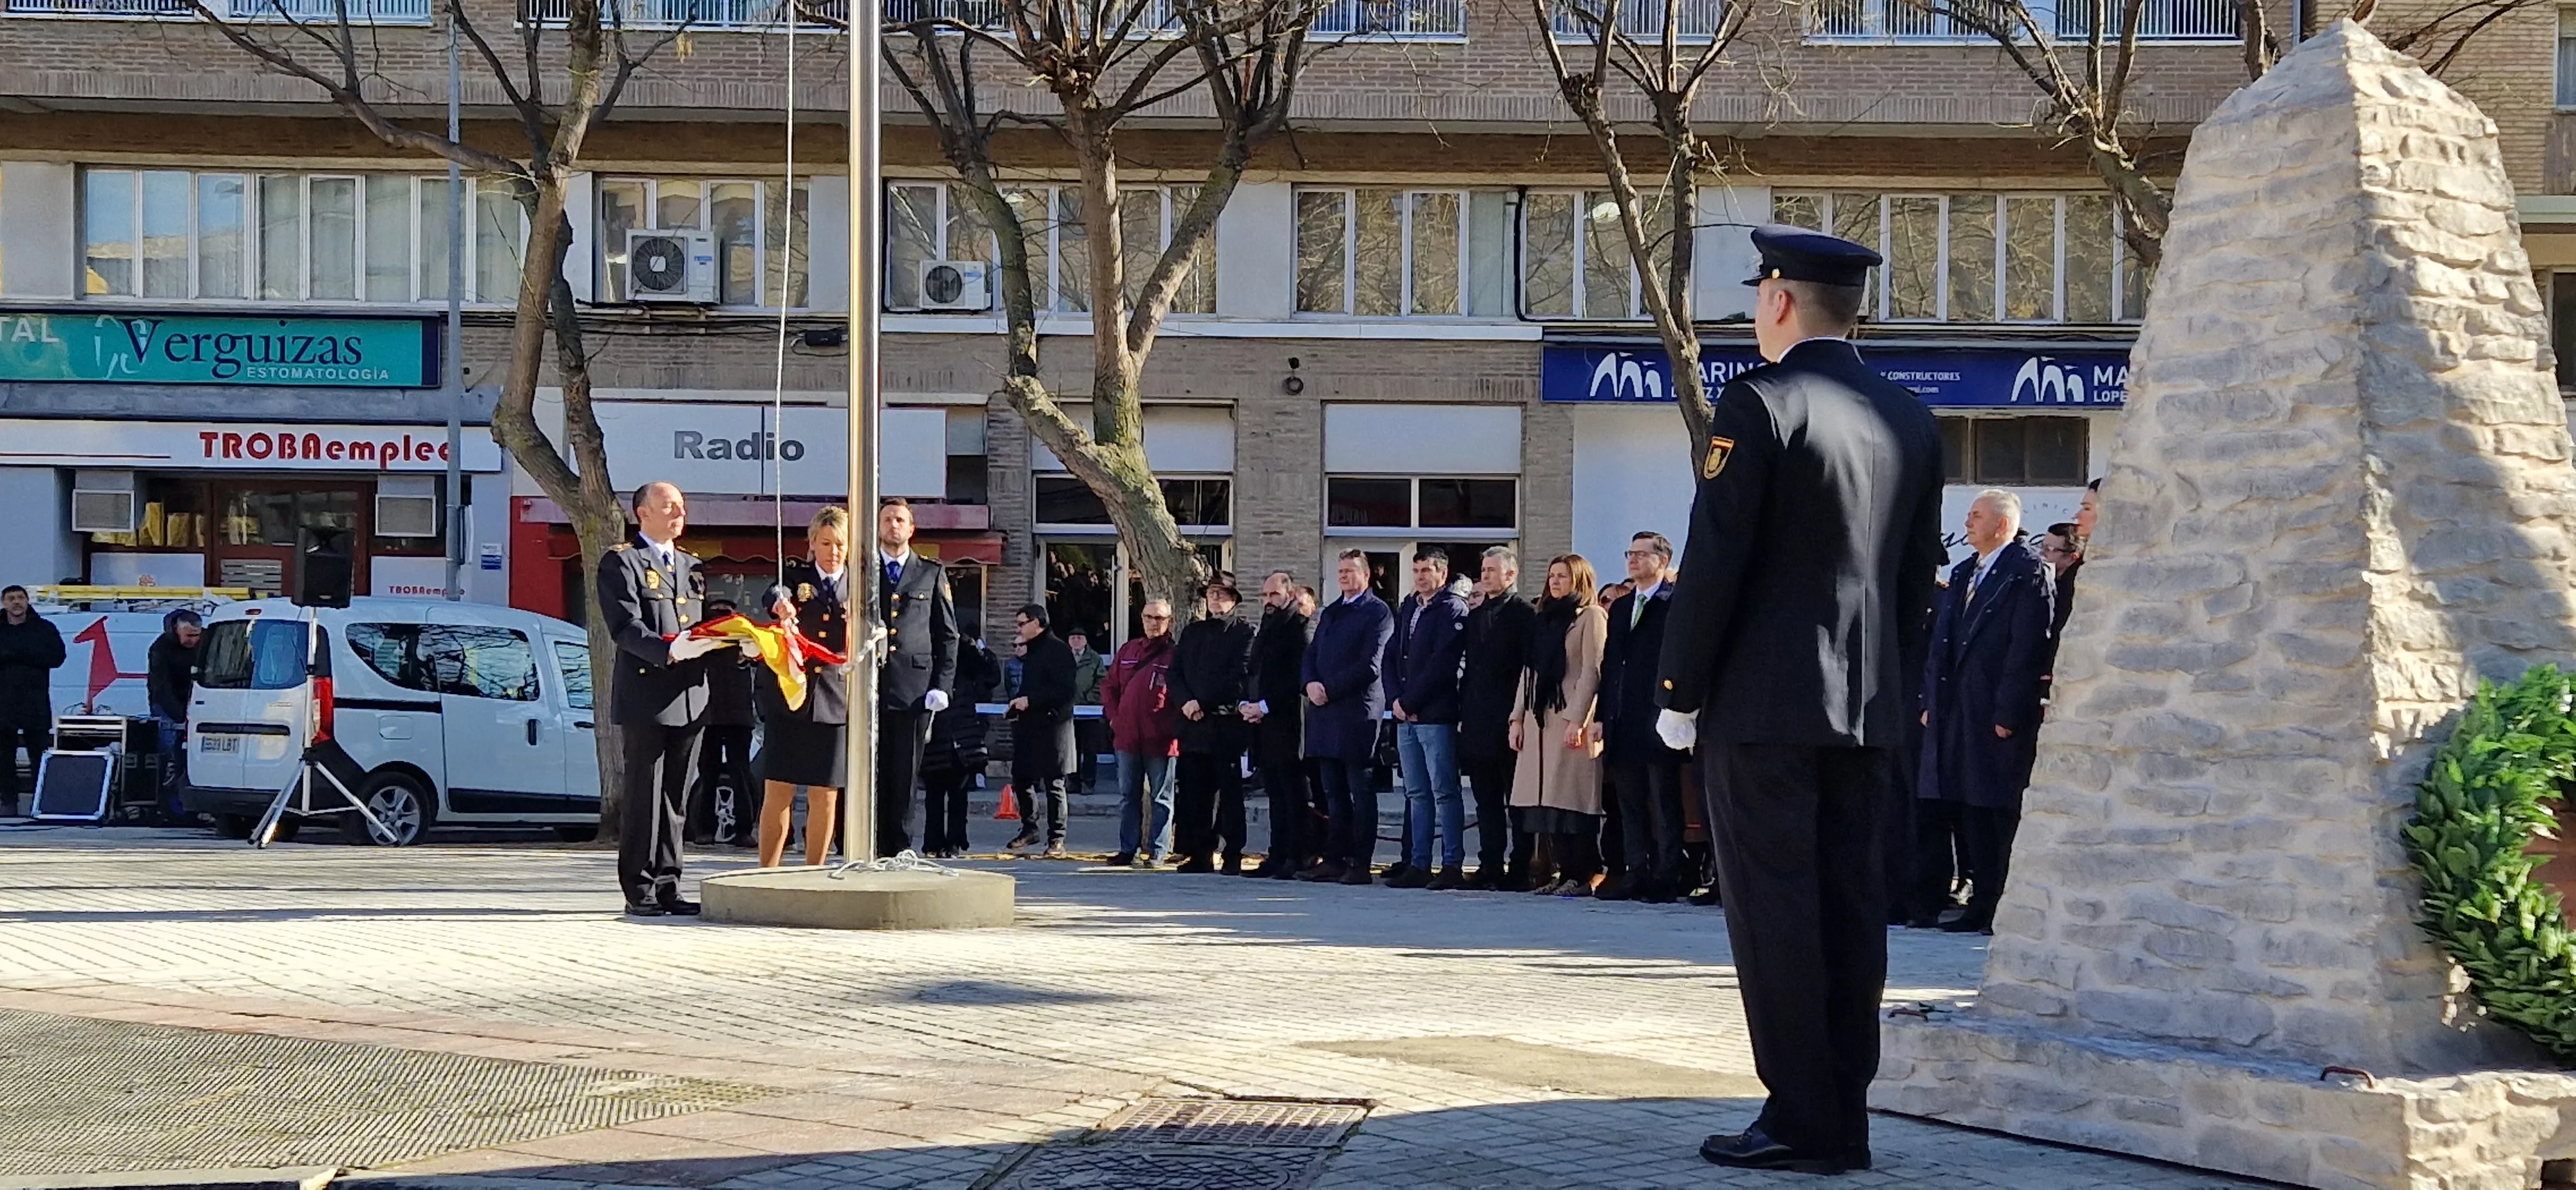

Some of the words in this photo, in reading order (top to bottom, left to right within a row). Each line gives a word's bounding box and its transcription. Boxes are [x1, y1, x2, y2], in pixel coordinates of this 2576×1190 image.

[120, 319, 363, 379] Verguizas
[1888, 371, 1961, 381] CONSTRUCTORES
[674, 430, 805, 461] Radio
